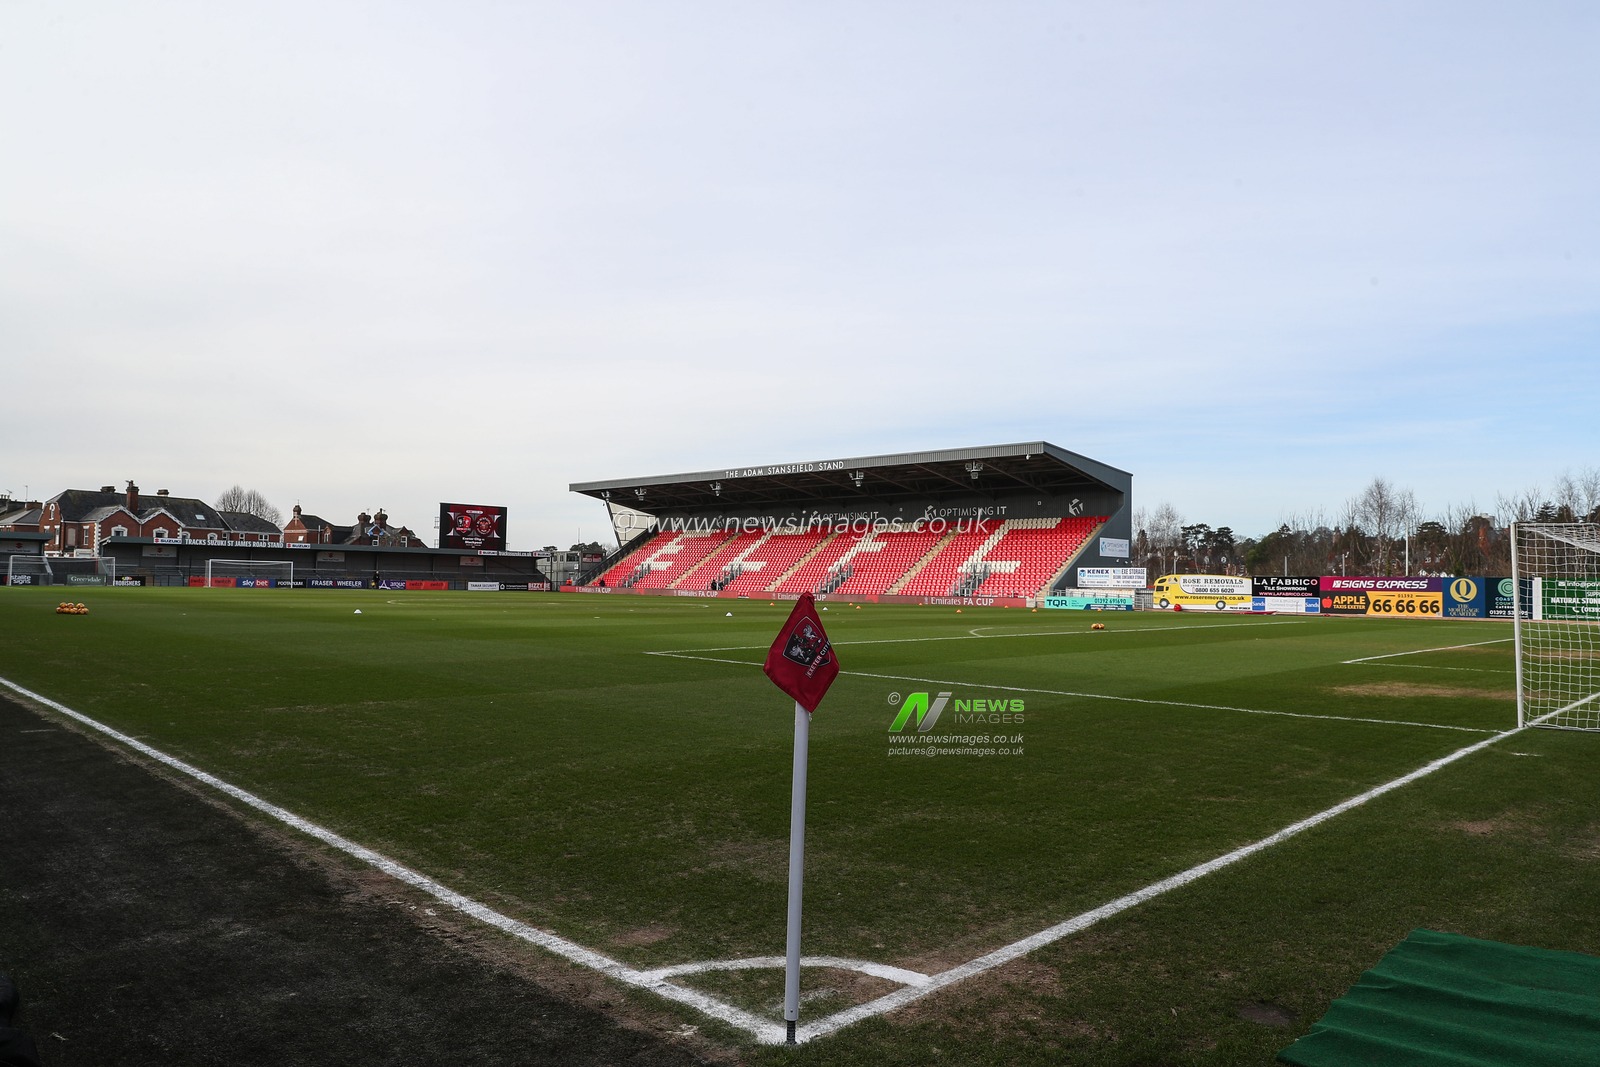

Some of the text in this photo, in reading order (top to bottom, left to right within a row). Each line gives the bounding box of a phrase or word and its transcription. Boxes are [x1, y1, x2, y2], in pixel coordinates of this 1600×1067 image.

[725, 461, 844, 478] THE ADAM STANSFIELD STAND
[939, 506, 1006, 517] OPTIMISING IT
[1341, 580, 1428, 589] SIGNS EXPRESS
[931, 597, 961, 606] Emirates
[976, 598, 994, 606] CUP
[1333, 596, 1366, 604] APPLE
[806, 655, 823, 676] EXETER
